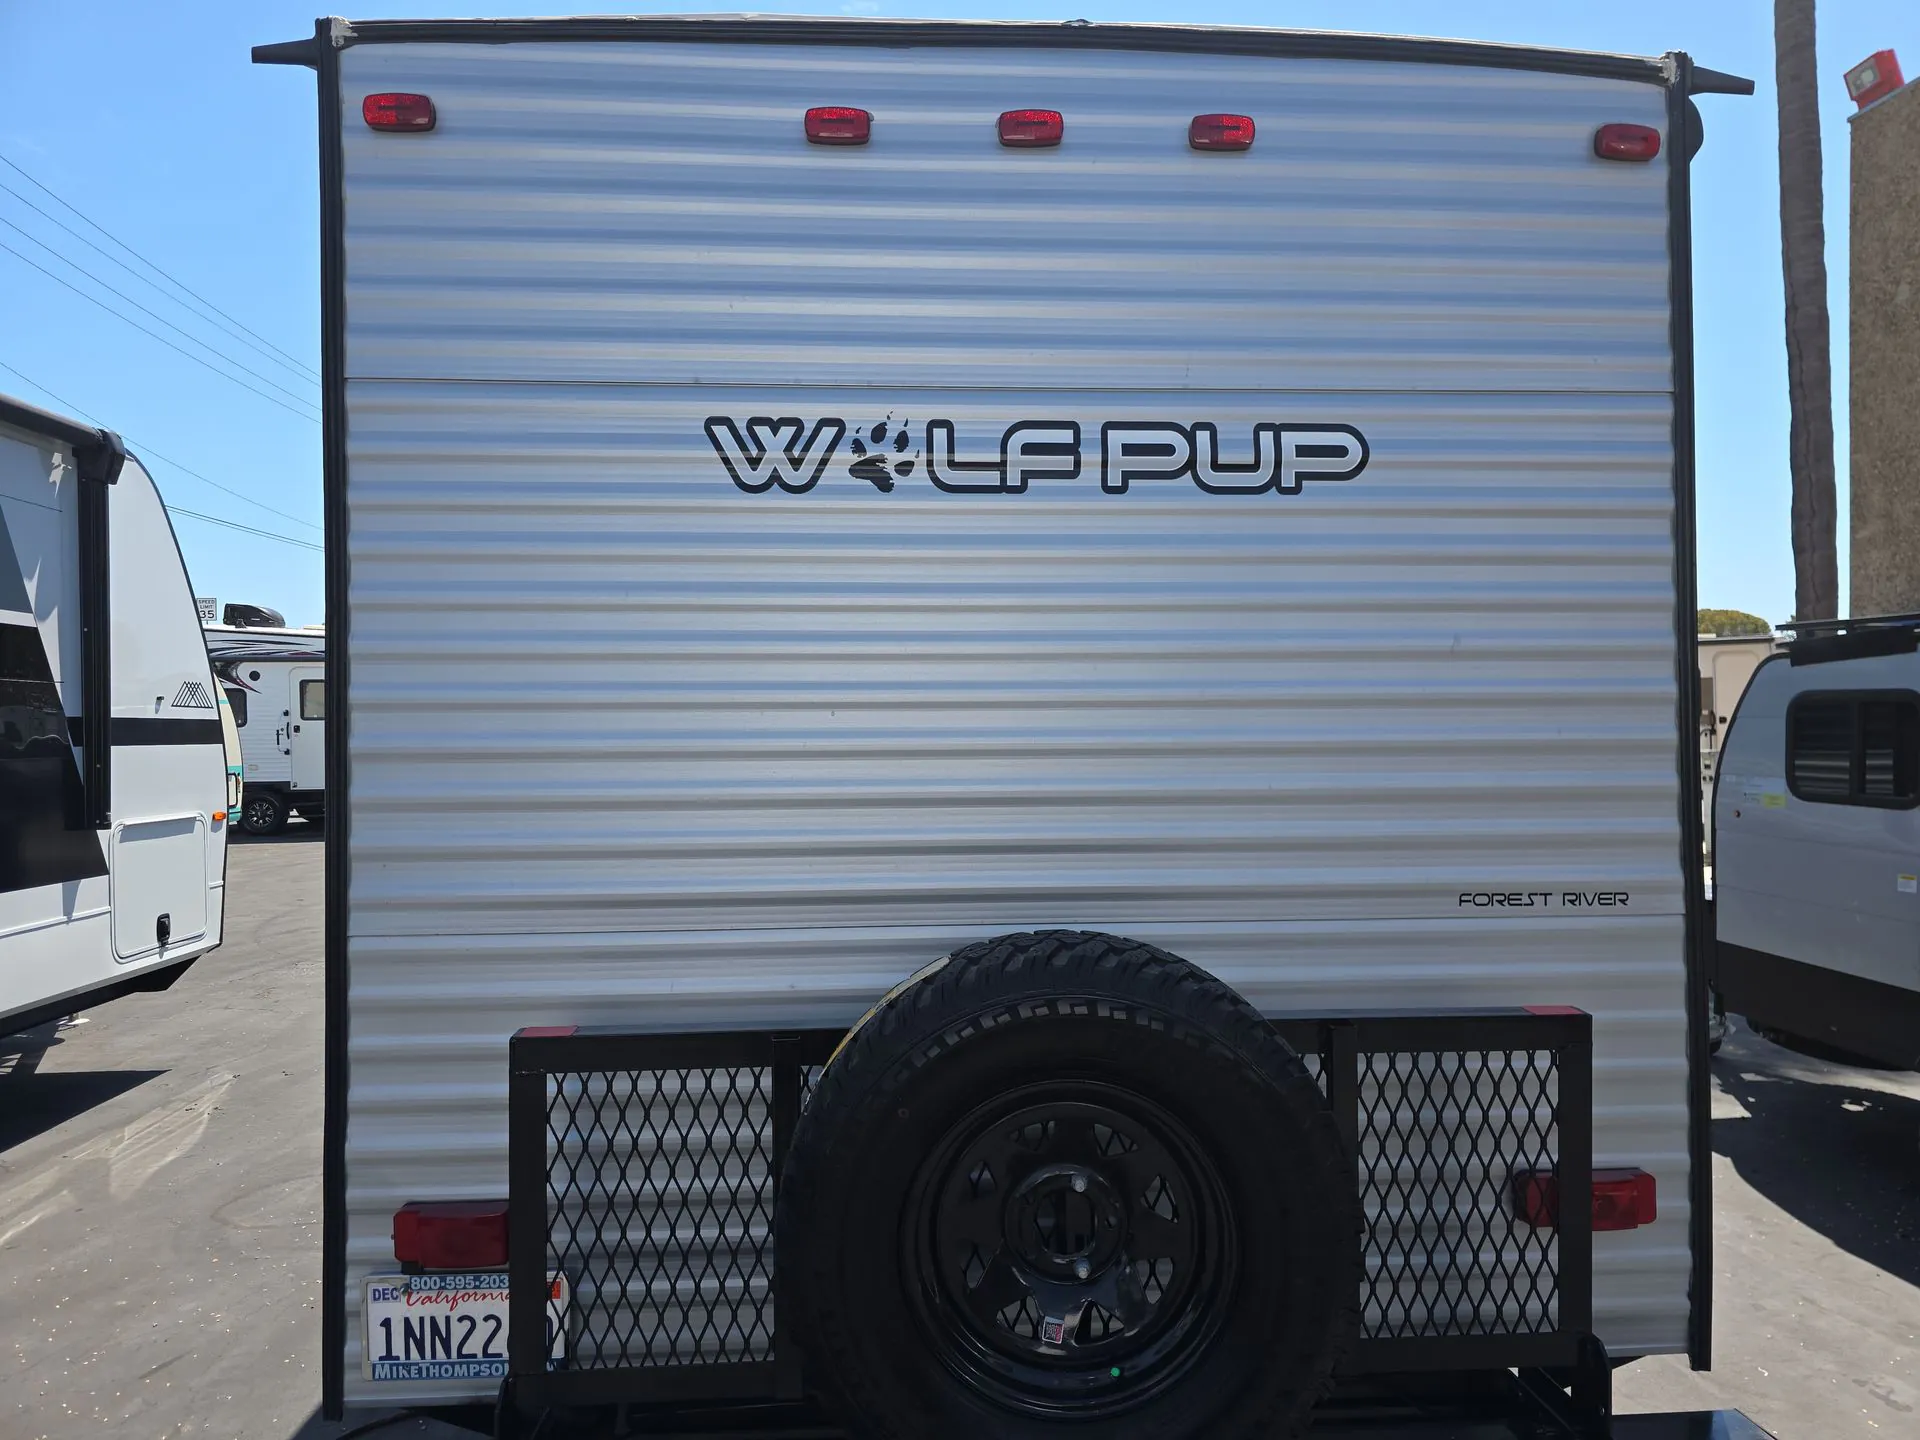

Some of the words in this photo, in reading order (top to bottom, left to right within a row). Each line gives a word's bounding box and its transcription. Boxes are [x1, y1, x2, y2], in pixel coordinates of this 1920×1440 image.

[704, 414, 1081, 495] WLF
[1100, 421, 1370, 495] PUP
[200, 610, 214, 618] 35
[1459, 892, 1553, 907] FOREST
[1562, 891, 1629, 907] RIVER
[372, 1287, 399, 1302] DEC
[378, 1313, 554, 1361] 1NN22
